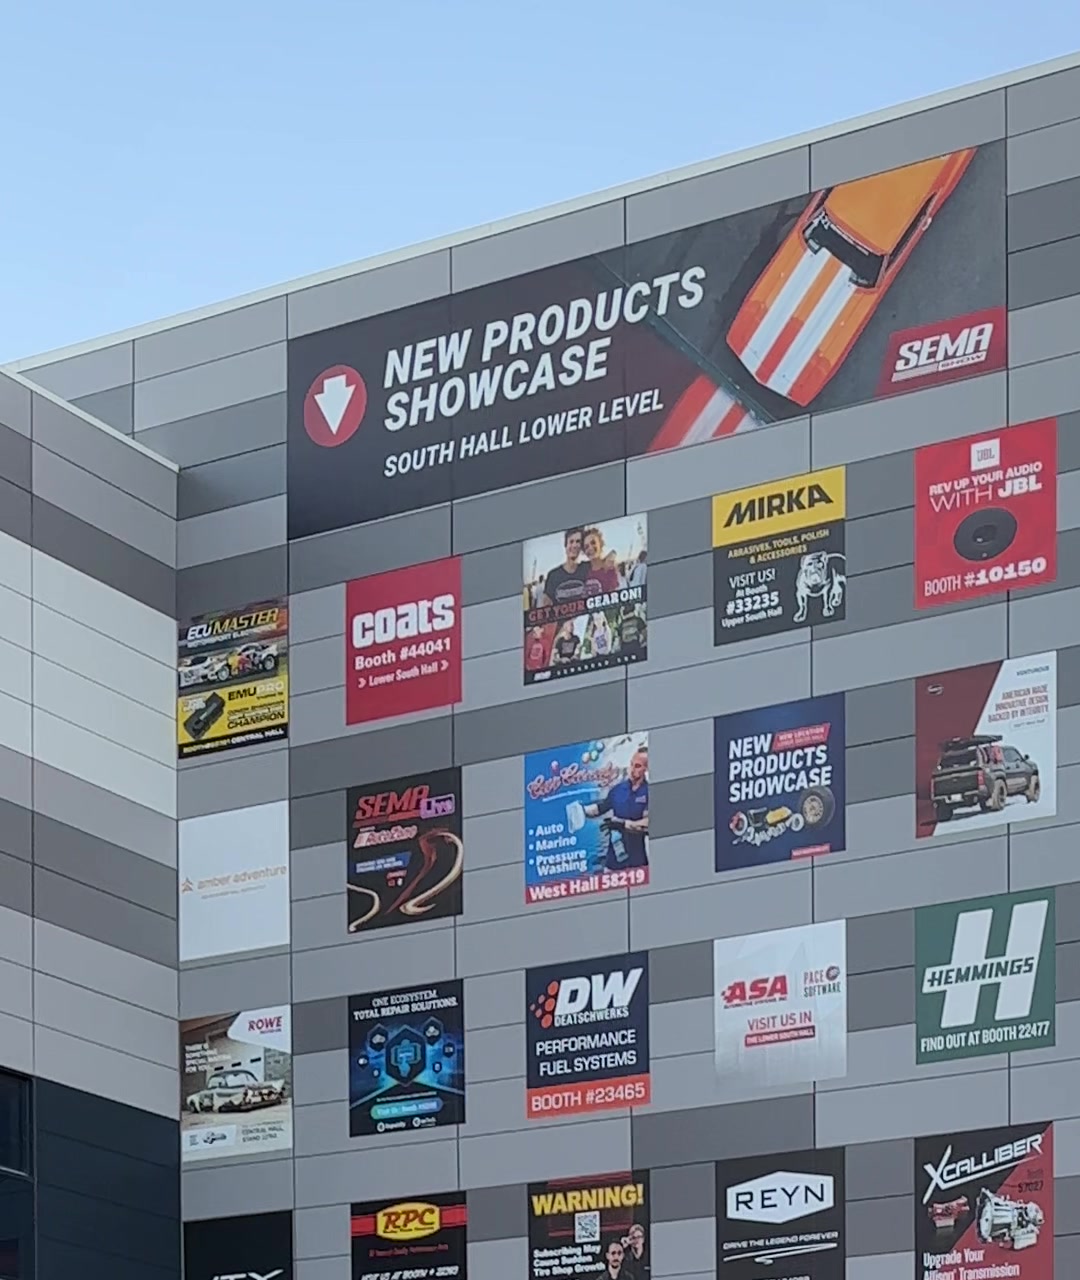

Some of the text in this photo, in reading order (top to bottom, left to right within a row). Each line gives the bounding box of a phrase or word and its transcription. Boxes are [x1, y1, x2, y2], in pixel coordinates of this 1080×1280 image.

[384, 267, 707, 388] NEW PRODUCTS
[895, 323, 994, 372] SEMA
[937, 351, 988, 371] SHOW
[384, 338, 612, 432] SHOWCASE
[384, 390, 664, 479] SOUTH HALL LOWER LEVEL
[928, 461, 1043, 497] REV UP YOUR AUDIO
[723, 484, 834, 529] MIRKA
[930, 475, 1043, 513] WITH JBL
[728, 528, 830, 559] ABRASIVES, POLISH
[756, 544, 808, 563] ACCESSORIES
[729, 567, 777, 590] VISIT US!
[924, 557, 1047, 598] BOOTH #10150
[528, 585, 643, 623] GET YOUR GEAR ON!
[726, 590, 780, 617] #33235
[721, 612, 745, 630] Upper
[355, 636, 451, 671] Booth #44041
[728, 733, 772, 760] NEW
[728, 745, 828, 782] PRODUCTS
[728, 766, 832, 803] SHOWCASE
[535, 823, 564, 837] Auto
[535, 835, 577, 851] Marine
[535, 850, 587, 867] Pressure
[537, 859, 588, 877] Washing
[529, 870, 645, 902] West Hall 58219
[803, 969, 825, 984] PACE
[927, 956, 1035, 988] HEMMINGS
[555, 967, 644, 1016] DW
[723, 975, 788, 1004] ASA
[803, 981, 842, 998] SOFTWARE
[248, 1015, 283, 1033] ROWE
[354, 1004, 411, 1022] TOTAL REPAIR
[554, 1007, 630, 1028] DEATSCHWERKS
[747, 1011, 813, 1031] VISIT US IN
[535, 1029, 637, 1057] PERFORMANCE
[921, 1020, 1050, 1053] FIND OUT AT BOOTH 22477
[539, 1051, 637, 1077] FUEL SYSTEMS
[531, 1082, 646, 1112] BOOTH #23465
[922, 1133, 1044, 1206] XCALLIBER
[531, 1183, 645, 1216] WARNING!
[735, 1183, 826, 1212] REYN
[382, 1208, 436, 1232] RPC
[749, 1237, 765, 1249] THE
[552, 1260, 606, 1278] Shop Growth
[923, 1248, 986, 1269] Upgrade Your
